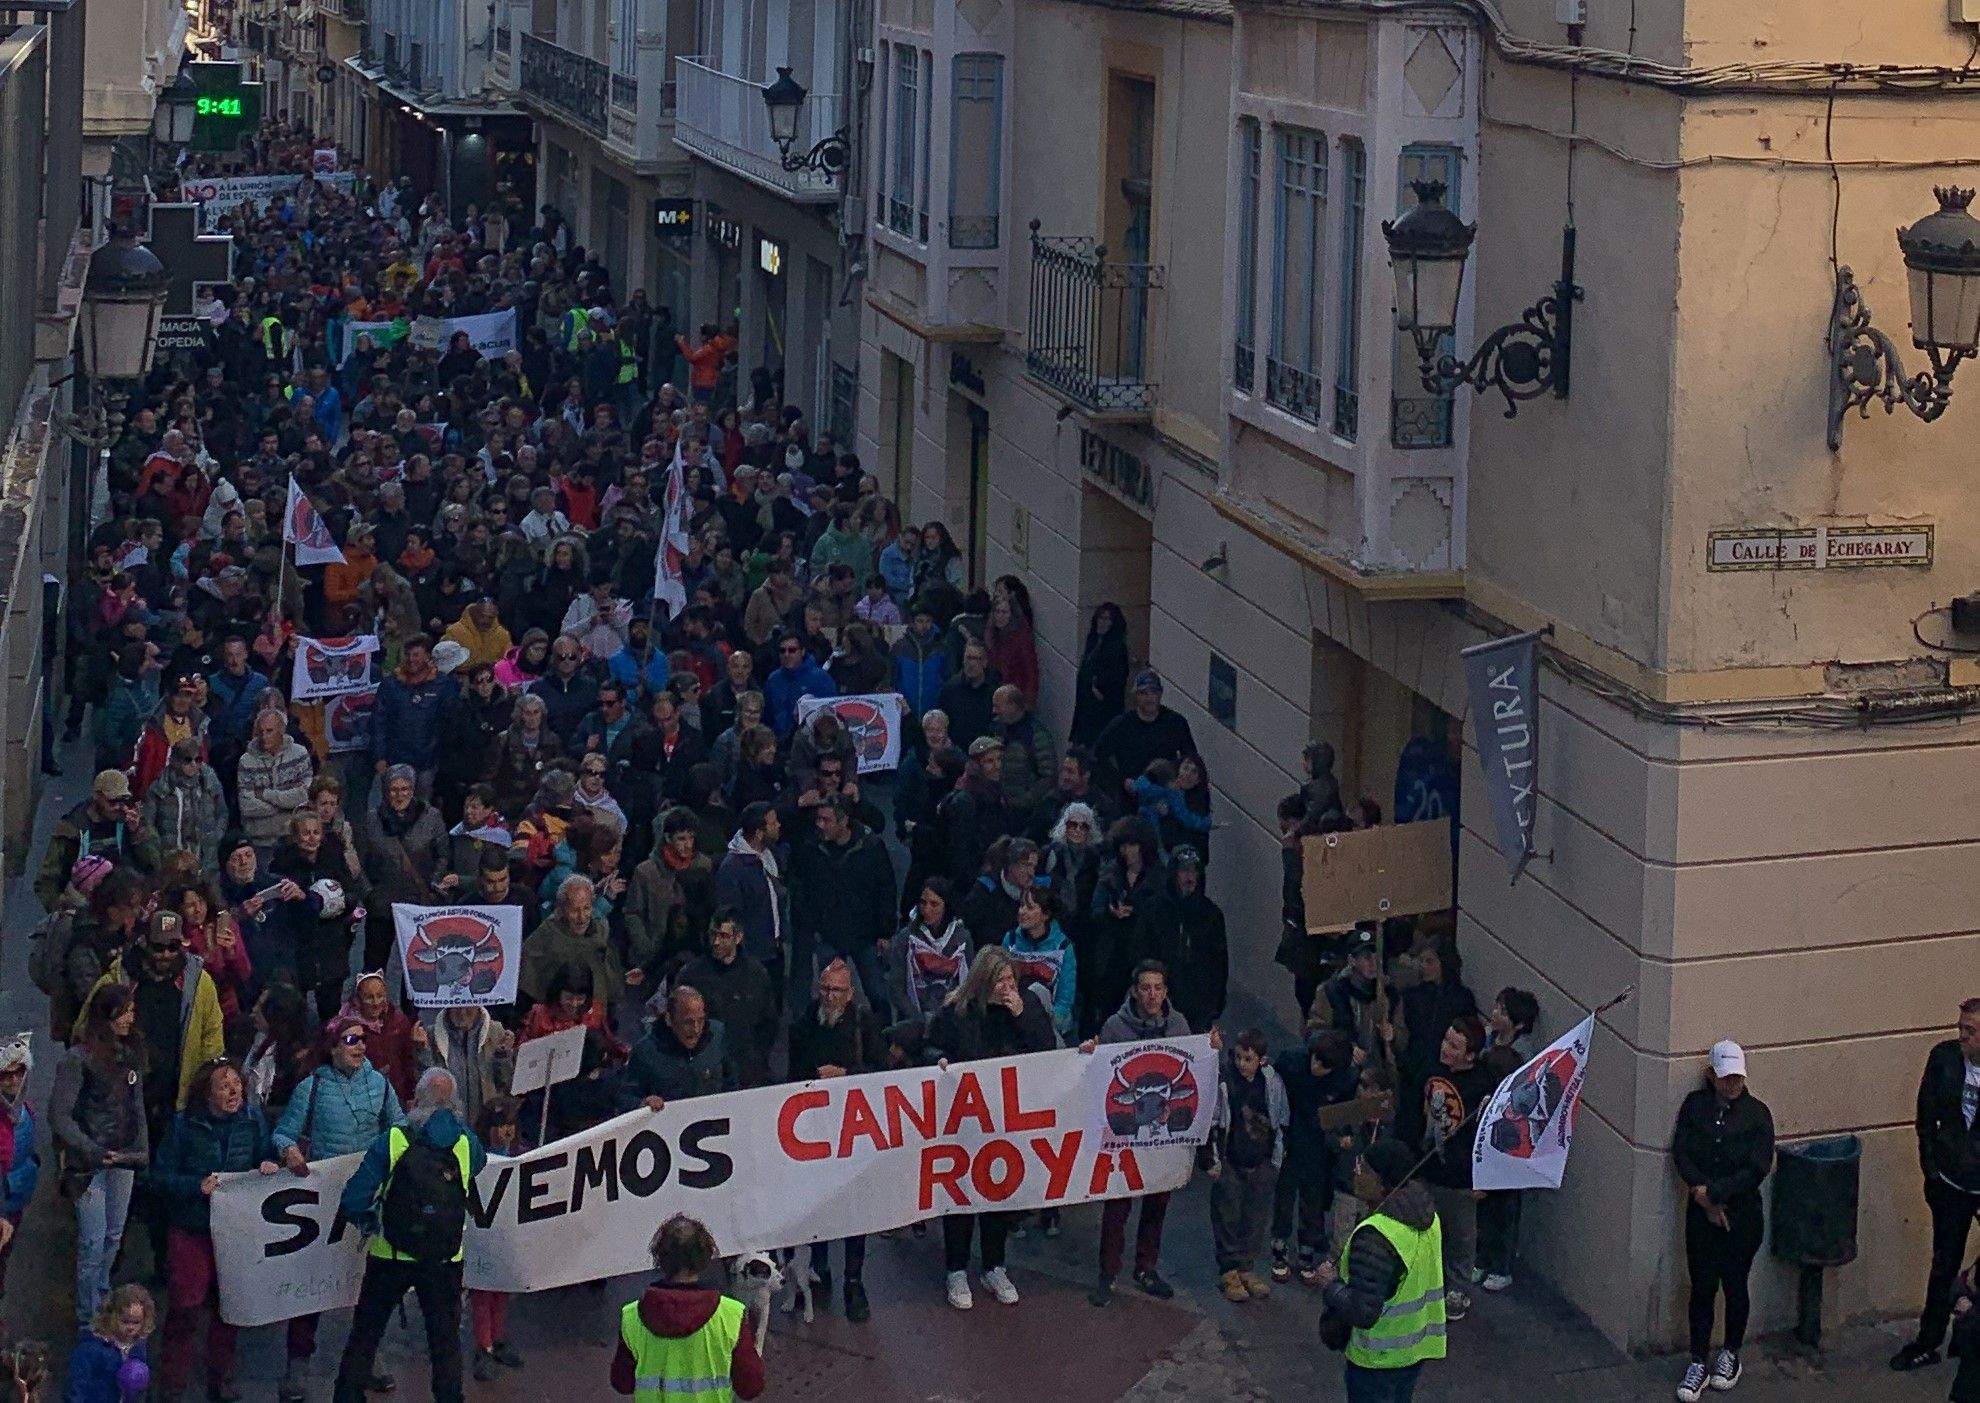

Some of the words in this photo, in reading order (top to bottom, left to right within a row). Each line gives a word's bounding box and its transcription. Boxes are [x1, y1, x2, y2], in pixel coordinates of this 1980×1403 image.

[197, 98, 241, 115] 9:41
[184, 184, 217, 200] NO
[160, 322, 201, 332] MACIA
[158, 337, 206, 348] OPEDIA
[1732, 541, 1788, 560] CALLE
[1800, 544, 1817, 558] DE
[1827, 538, 1914, 557] ECHEGARAY
[1574, 1038, 1586, 1056] NO
[260, 1117, 734, 1258] SVEMOS
[777, 1066, 1056, 1162] CANAL
[918, 1129, 1145, 1211] ROYA
